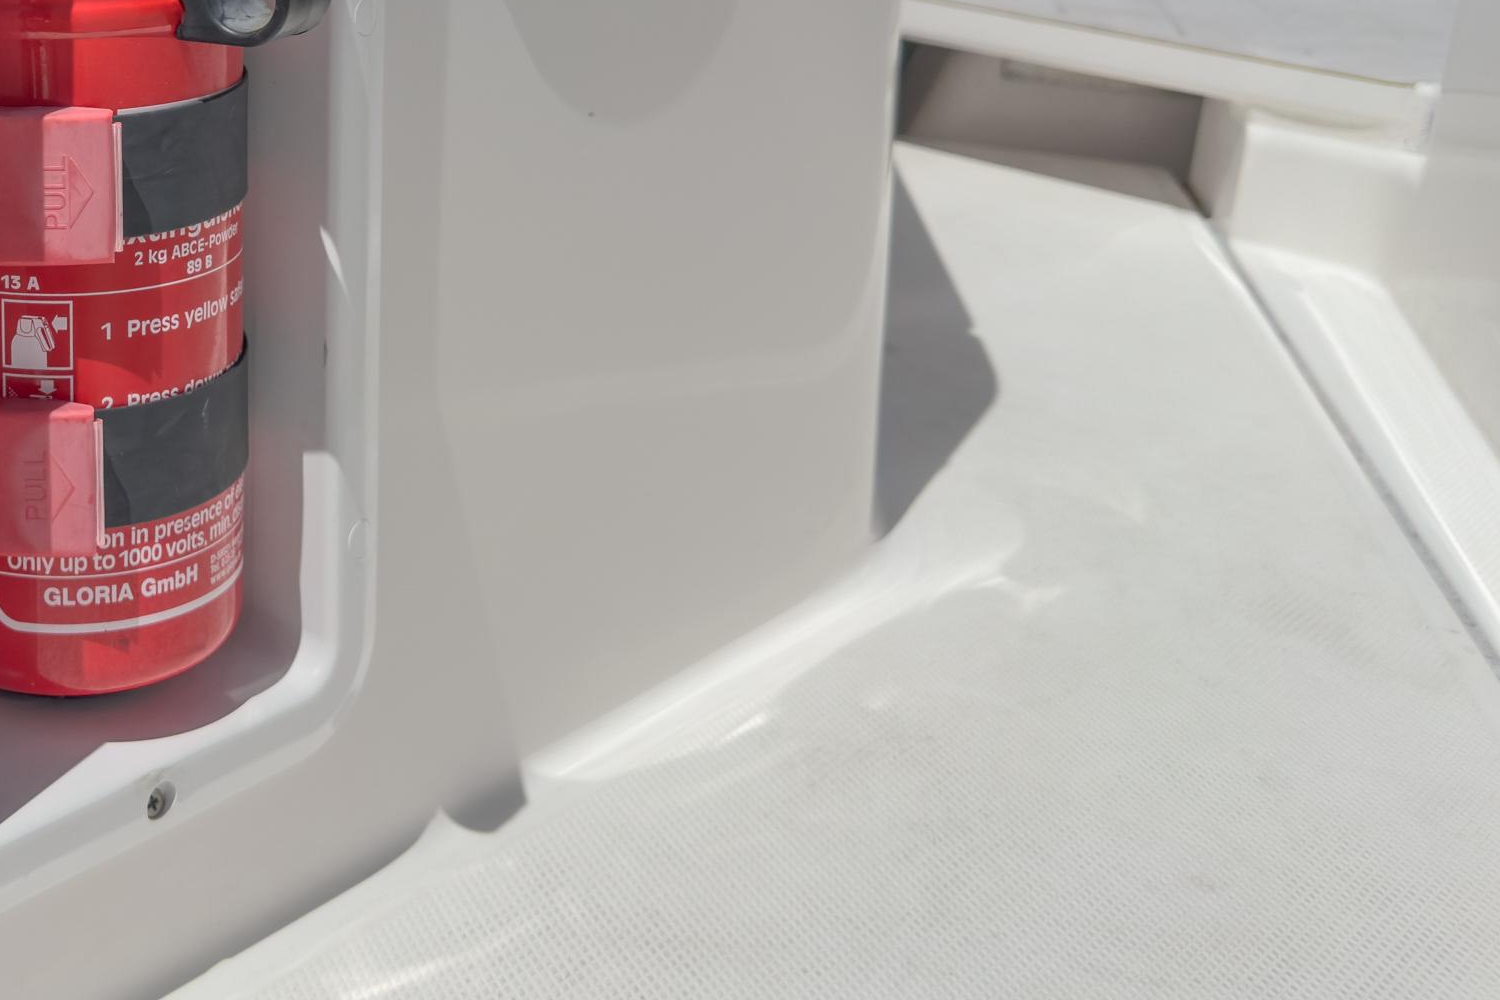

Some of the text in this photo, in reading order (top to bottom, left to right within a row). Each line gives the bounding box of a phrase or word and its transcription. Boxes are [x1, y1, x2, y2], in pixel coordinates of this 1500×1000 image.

[43, 155, 69, 230] PULL
[134, 222, 239, 266] 2 kg ABCE-Powder
[186, 254, 213, 275] 89 B
[0, 274, 41, 291] 13 A
[101, 322, 112, 341] 1
[127, 313, 180, 338] Press
[184, 294, 228, 329] yellow
[24, 451, 49, 521] PULL
[131, 525, 149, 547] in
[154, 500, 222, 543] presence
[224, 486, 235, 510] of
[7, 555, 54, 575] Only
[60, 556, 88, 574] up
[93, 552, 116, 570] to
[119, 542, 162, 568] 1000
[43, 582, 134, 607] GLORIA
[140, 563, 198, 598] GmbH
